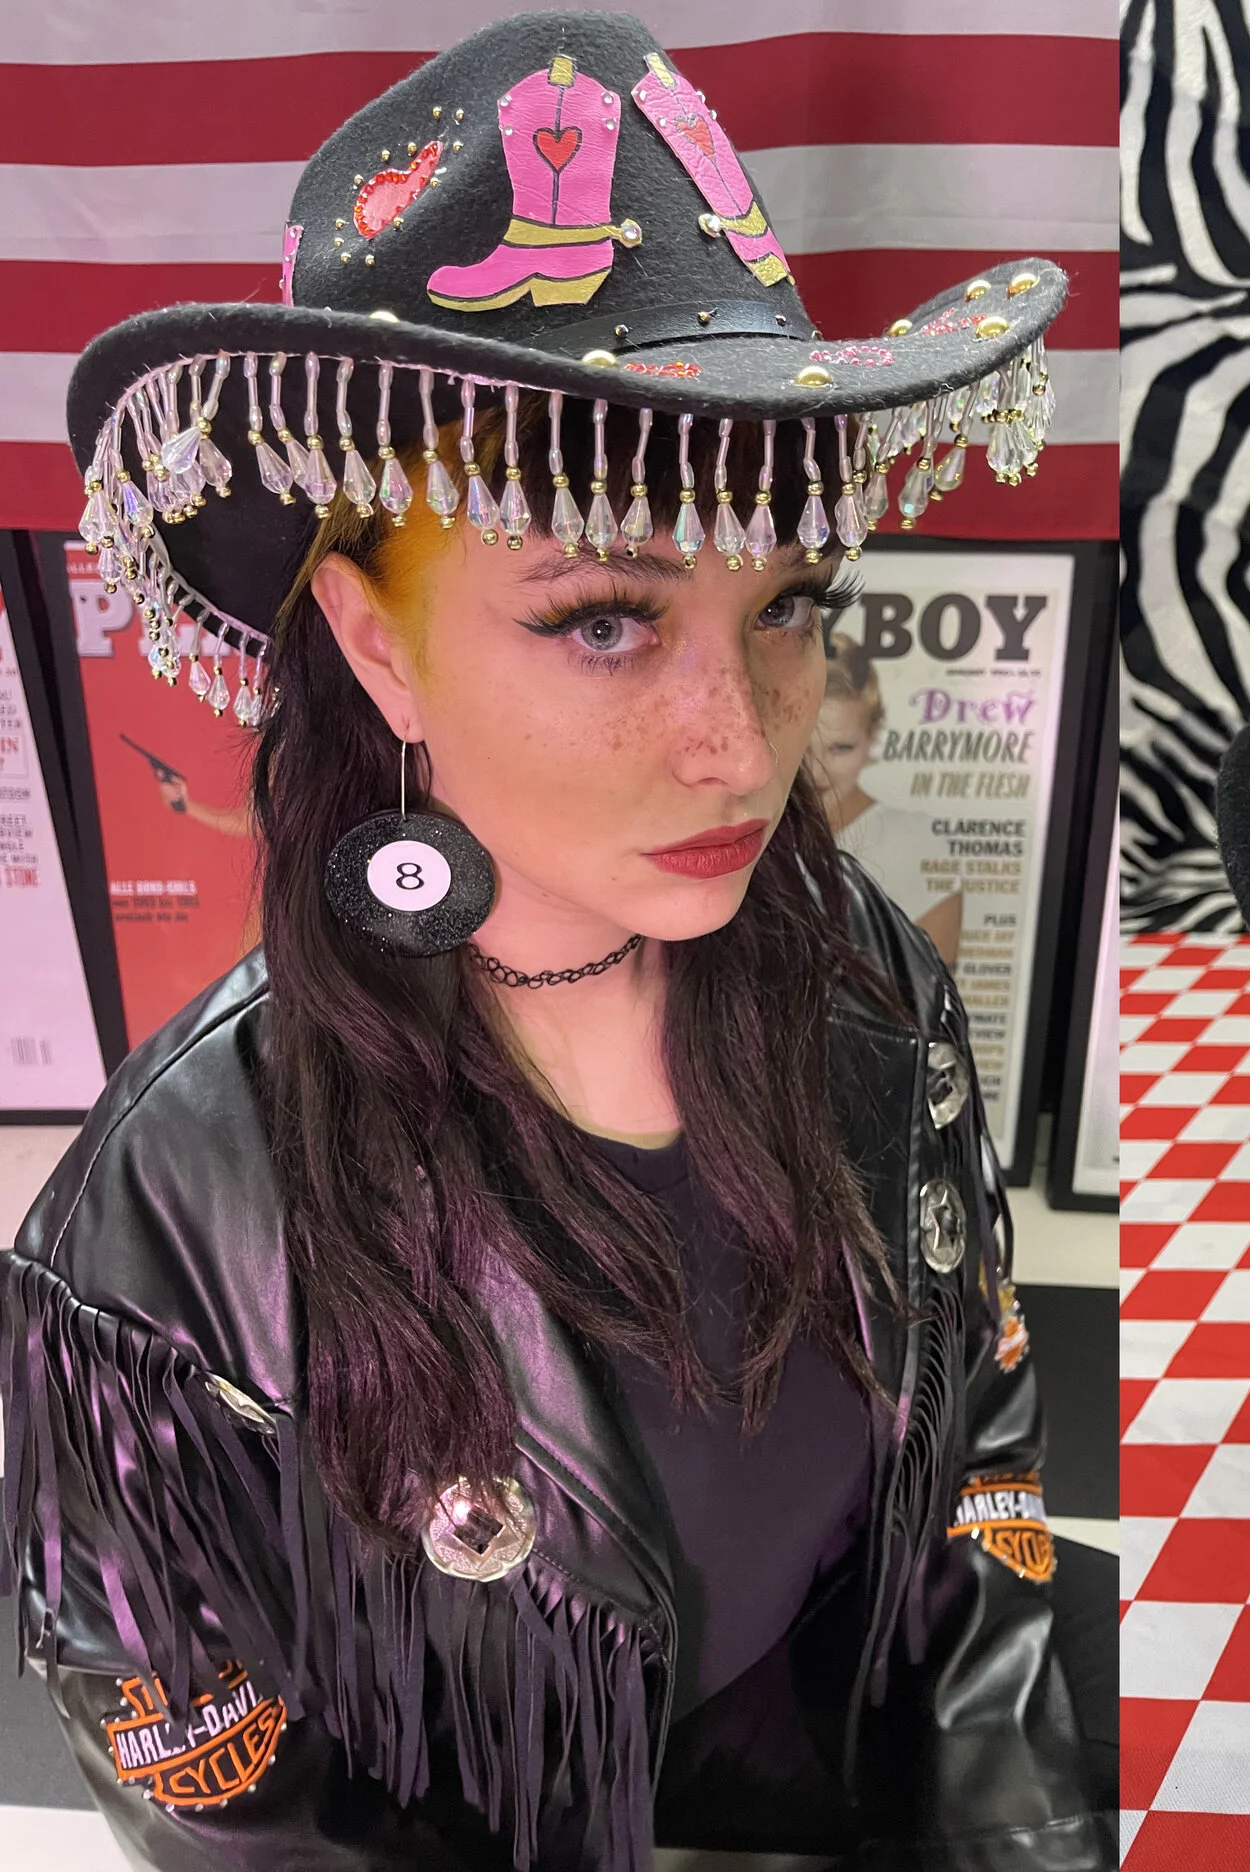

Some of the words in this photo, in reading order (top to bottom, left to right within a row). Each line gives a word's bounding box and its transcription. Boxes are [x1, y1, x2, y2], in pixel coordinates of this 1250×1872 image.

[908, 688, 1035, 726] Drew
[882, 729, 1036, 763] BARRYMORE
[910, 772, 933, 798] IN
[937, 772, 972, 799] THE
[975, 773, 1031, 800] FLESH
[931, 818, 1027, 837] CLARENCE
[946, 839, 1023, 857] THOMAS
[396, 862, 425, 890] 8
[966, 859, 1021, 877] STALKS
[925, 877, 955, 892] THE
[983, 912, 1017, 928] PLUS
[963, 963, 1012, 977] GLOVER
[169, 1707, 277, 1795] CYCLES
